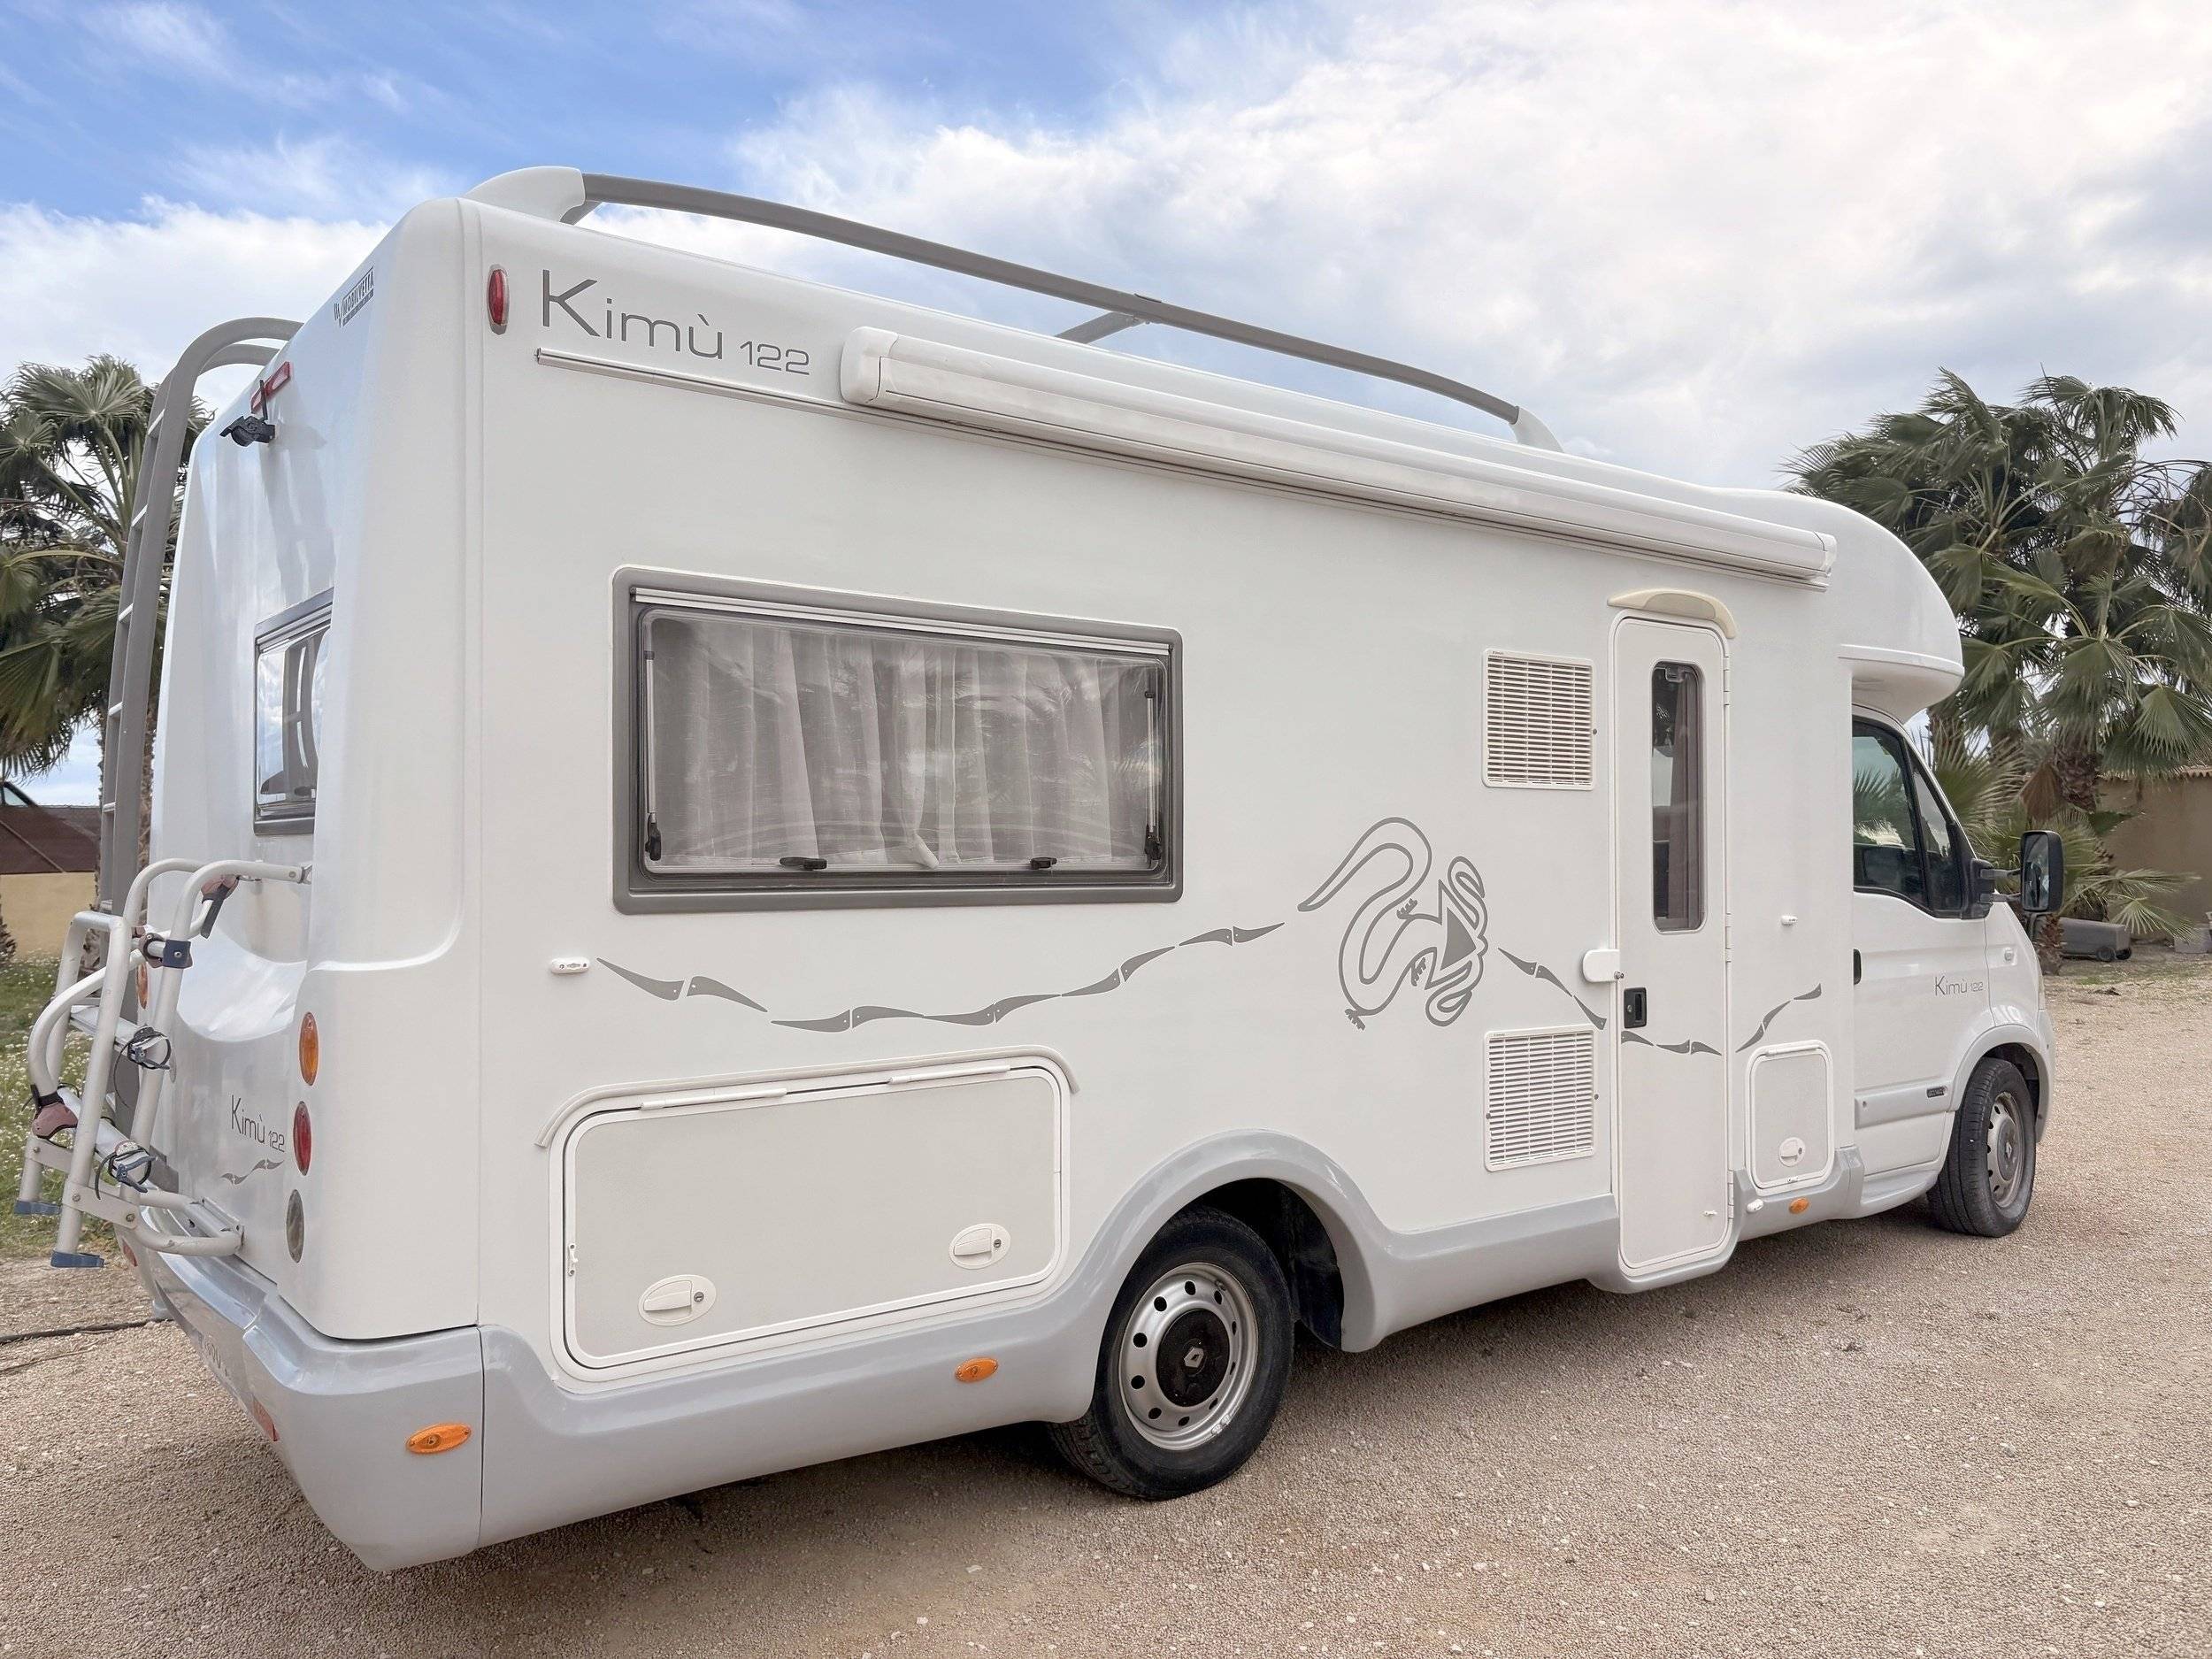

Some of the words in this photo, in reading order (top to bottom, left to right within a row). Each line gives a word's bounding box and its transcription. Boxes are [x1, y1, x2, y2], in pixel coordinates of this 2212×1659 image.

[542, 269, 722, 360] Kimù
[740, 341, 810, 375] 122
[1935, 975, 1968, 996] Kimù
[1970, 981, 1984, 992] 122
[231, 1094, 265, 1144] Kimù
[268, 1131, 285, 1153] 122
